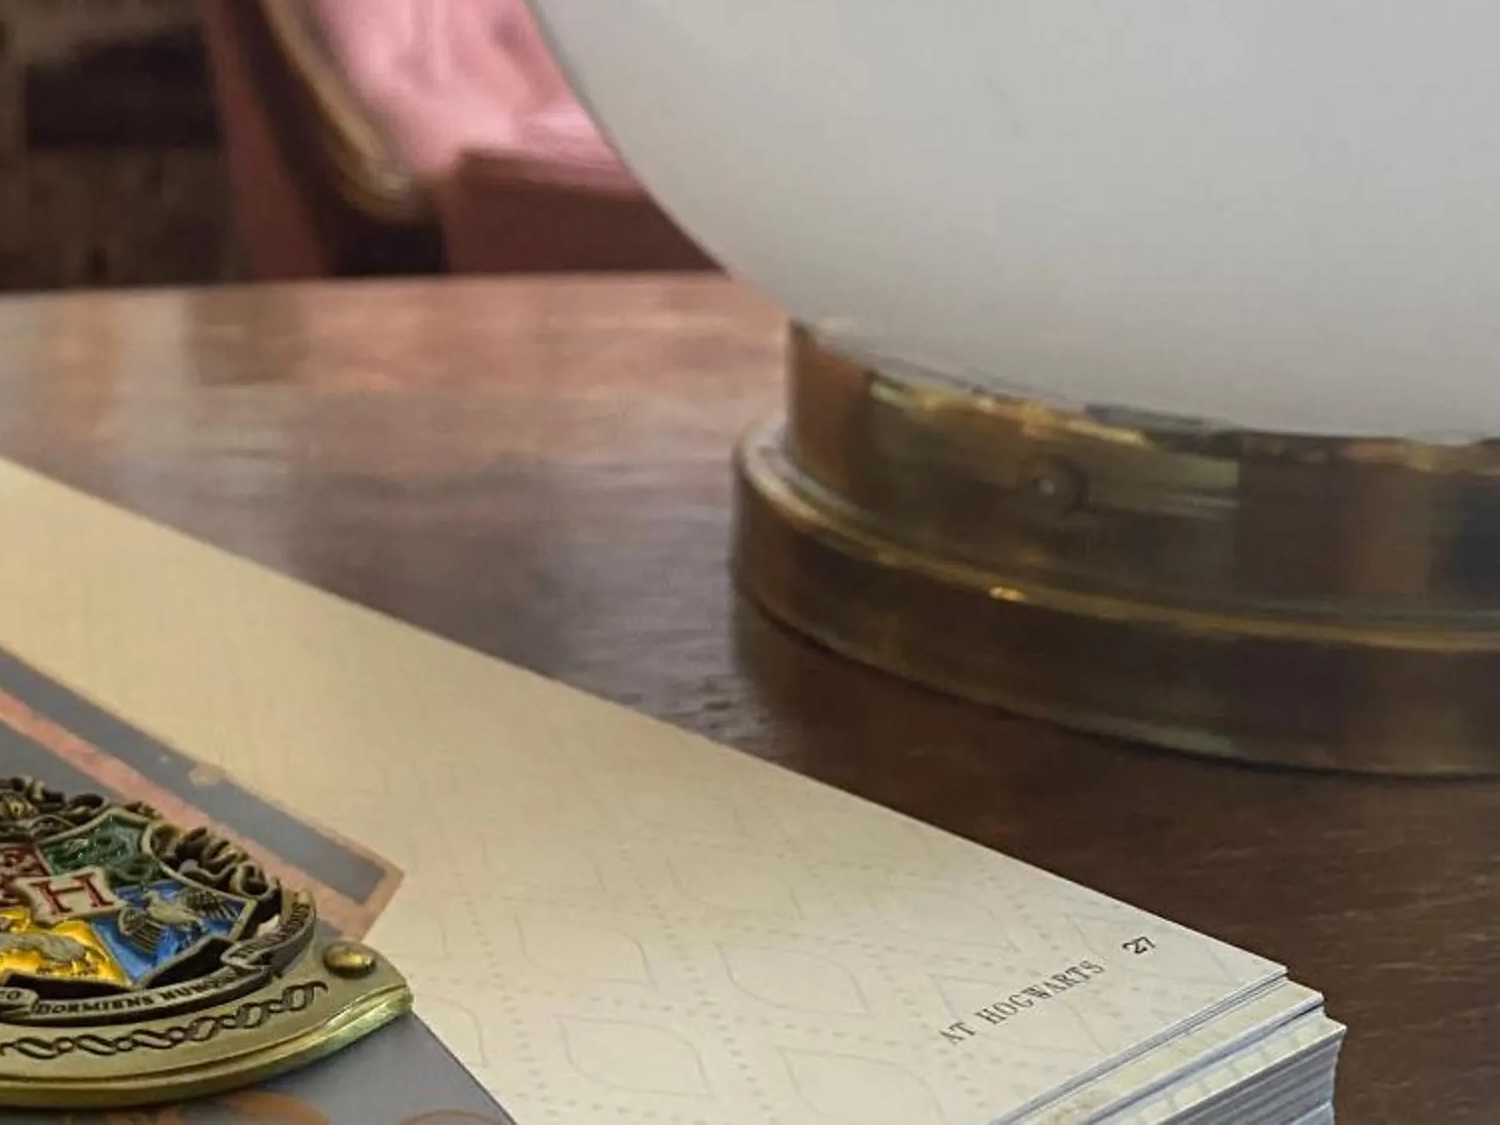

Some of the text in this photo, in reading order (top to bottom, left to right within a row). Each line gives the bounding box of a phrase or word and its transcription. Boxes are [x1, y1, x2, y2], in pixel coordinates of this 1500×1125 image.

[31, 876, 114, 917] H
[938, 936, 1157, 1046] AT HOGWARTS 27
